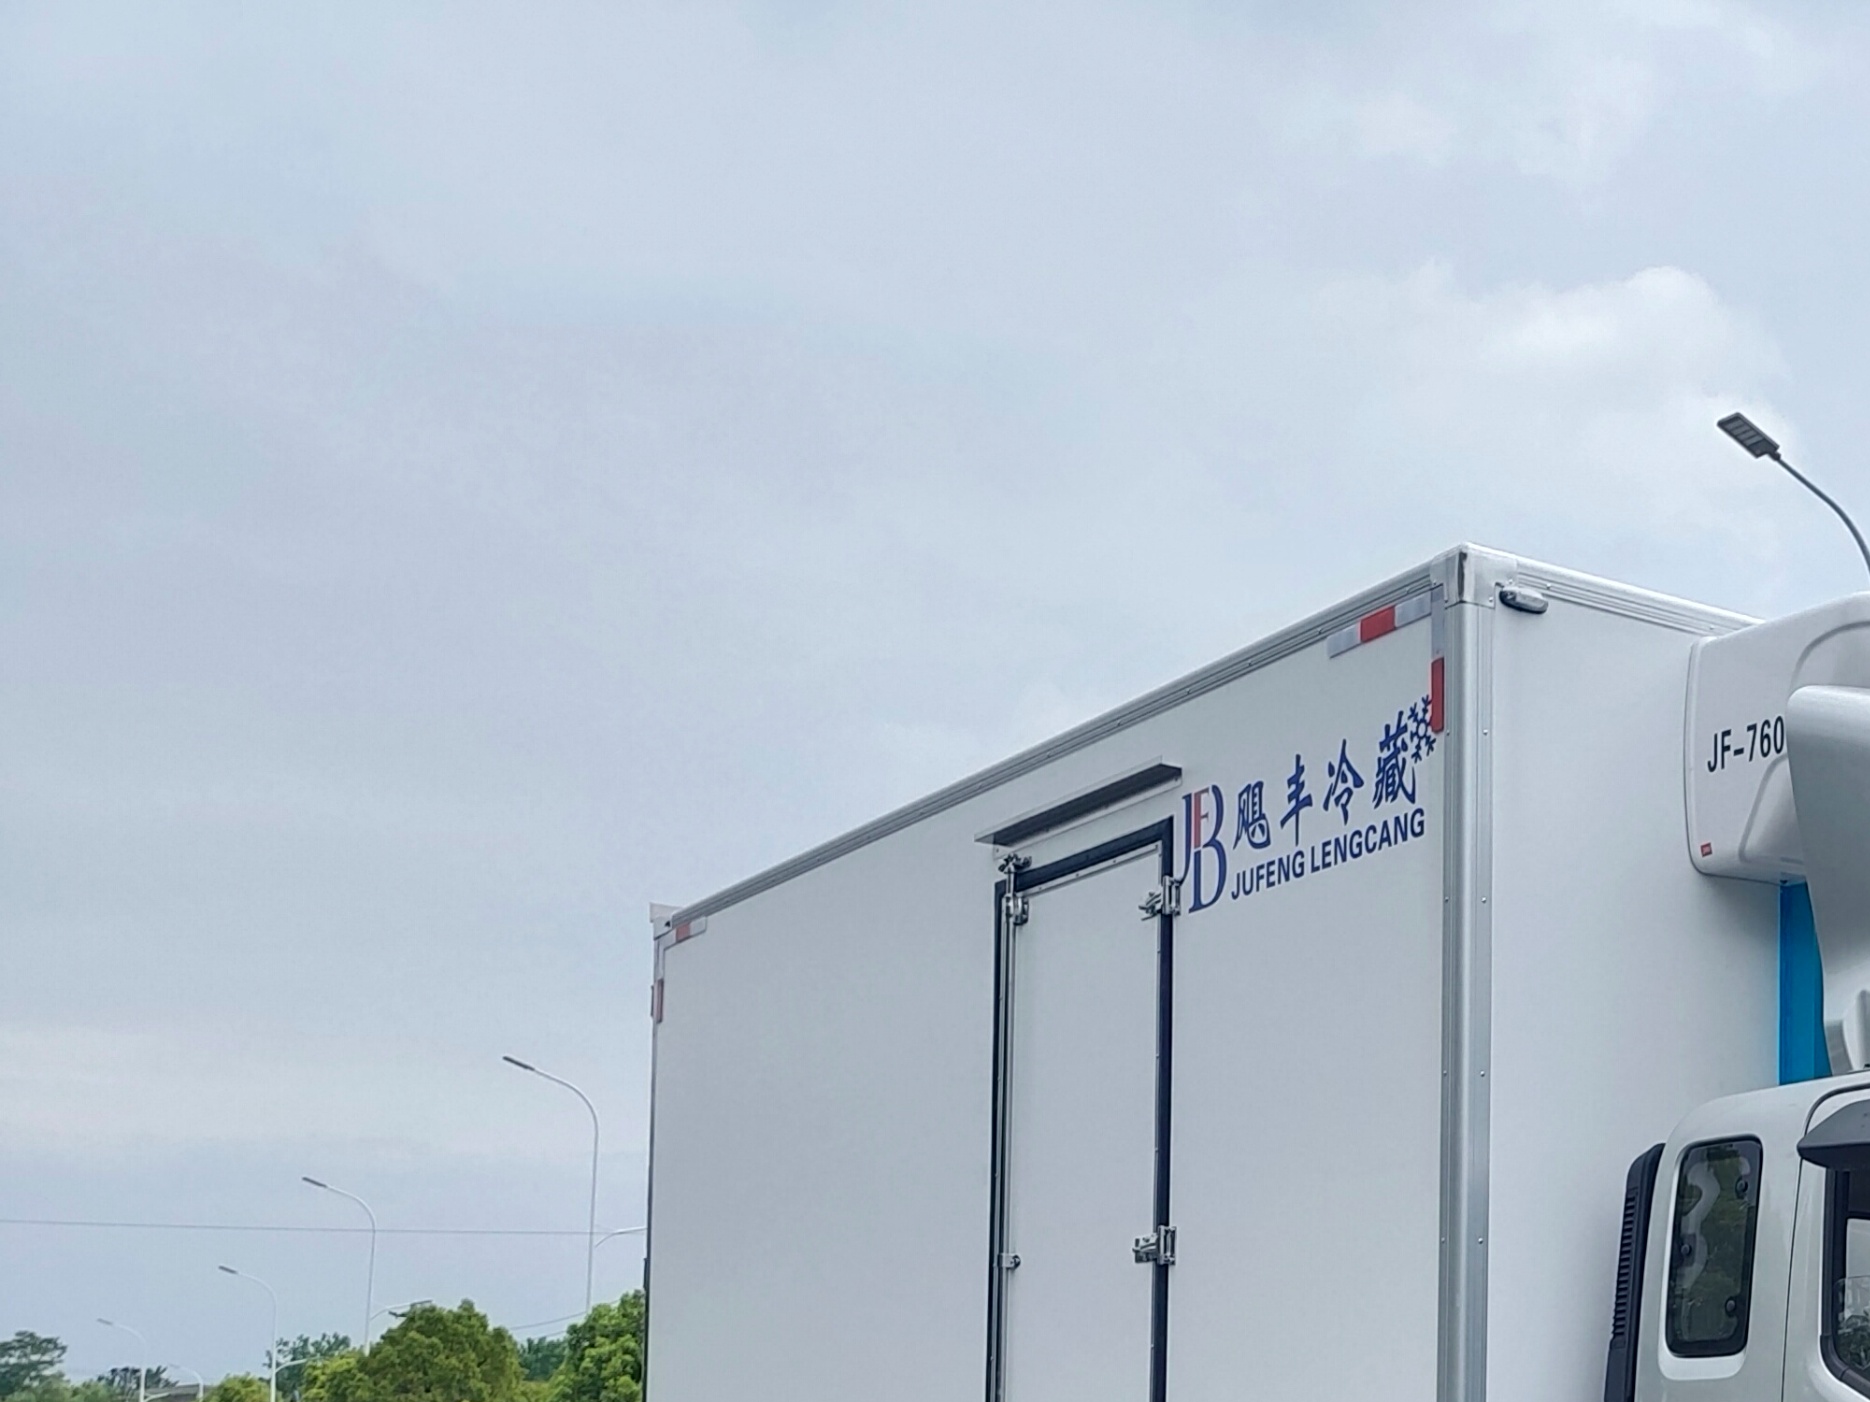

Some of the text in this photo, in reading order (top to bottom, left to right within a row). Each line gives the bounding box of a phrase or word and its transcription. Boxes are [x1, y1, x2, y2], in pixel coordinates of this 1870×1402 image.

[1707, 715, 1785, 773] JF-760
[1231, 808, 1425, 900] JUFENG LENGCANG
